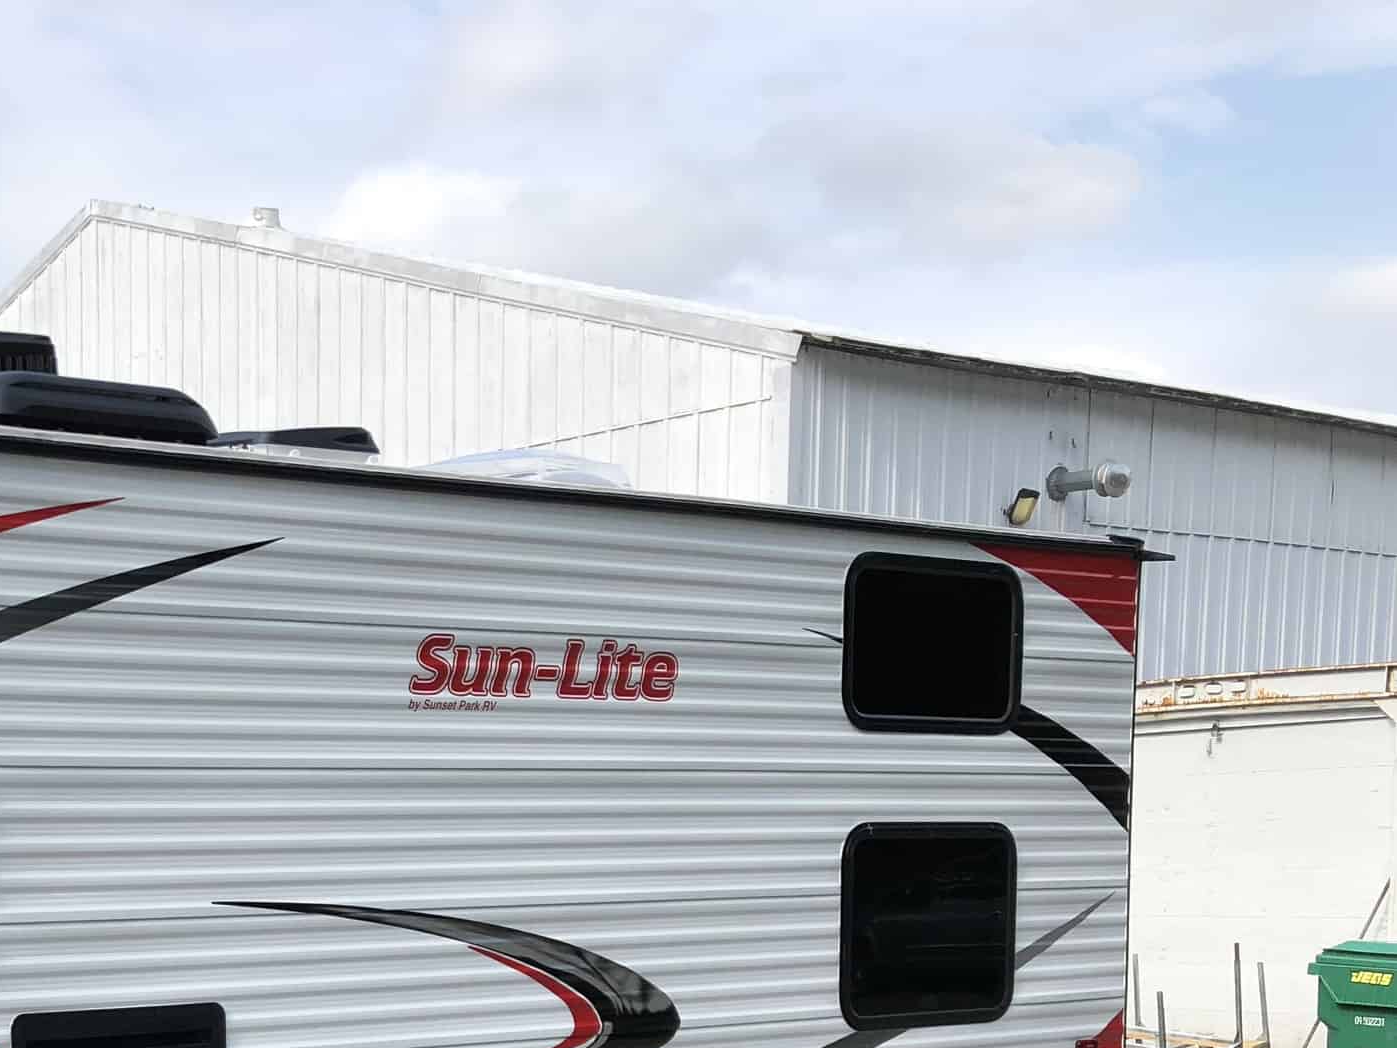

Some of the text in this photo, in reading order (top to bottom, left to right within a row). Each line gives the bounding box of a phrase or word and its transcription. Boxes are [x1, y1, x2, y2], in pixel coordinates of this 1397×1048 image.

[408, 633, 679, 702] Sun-Lite
[409, 699, 498, 711] by Sunset Park RV
